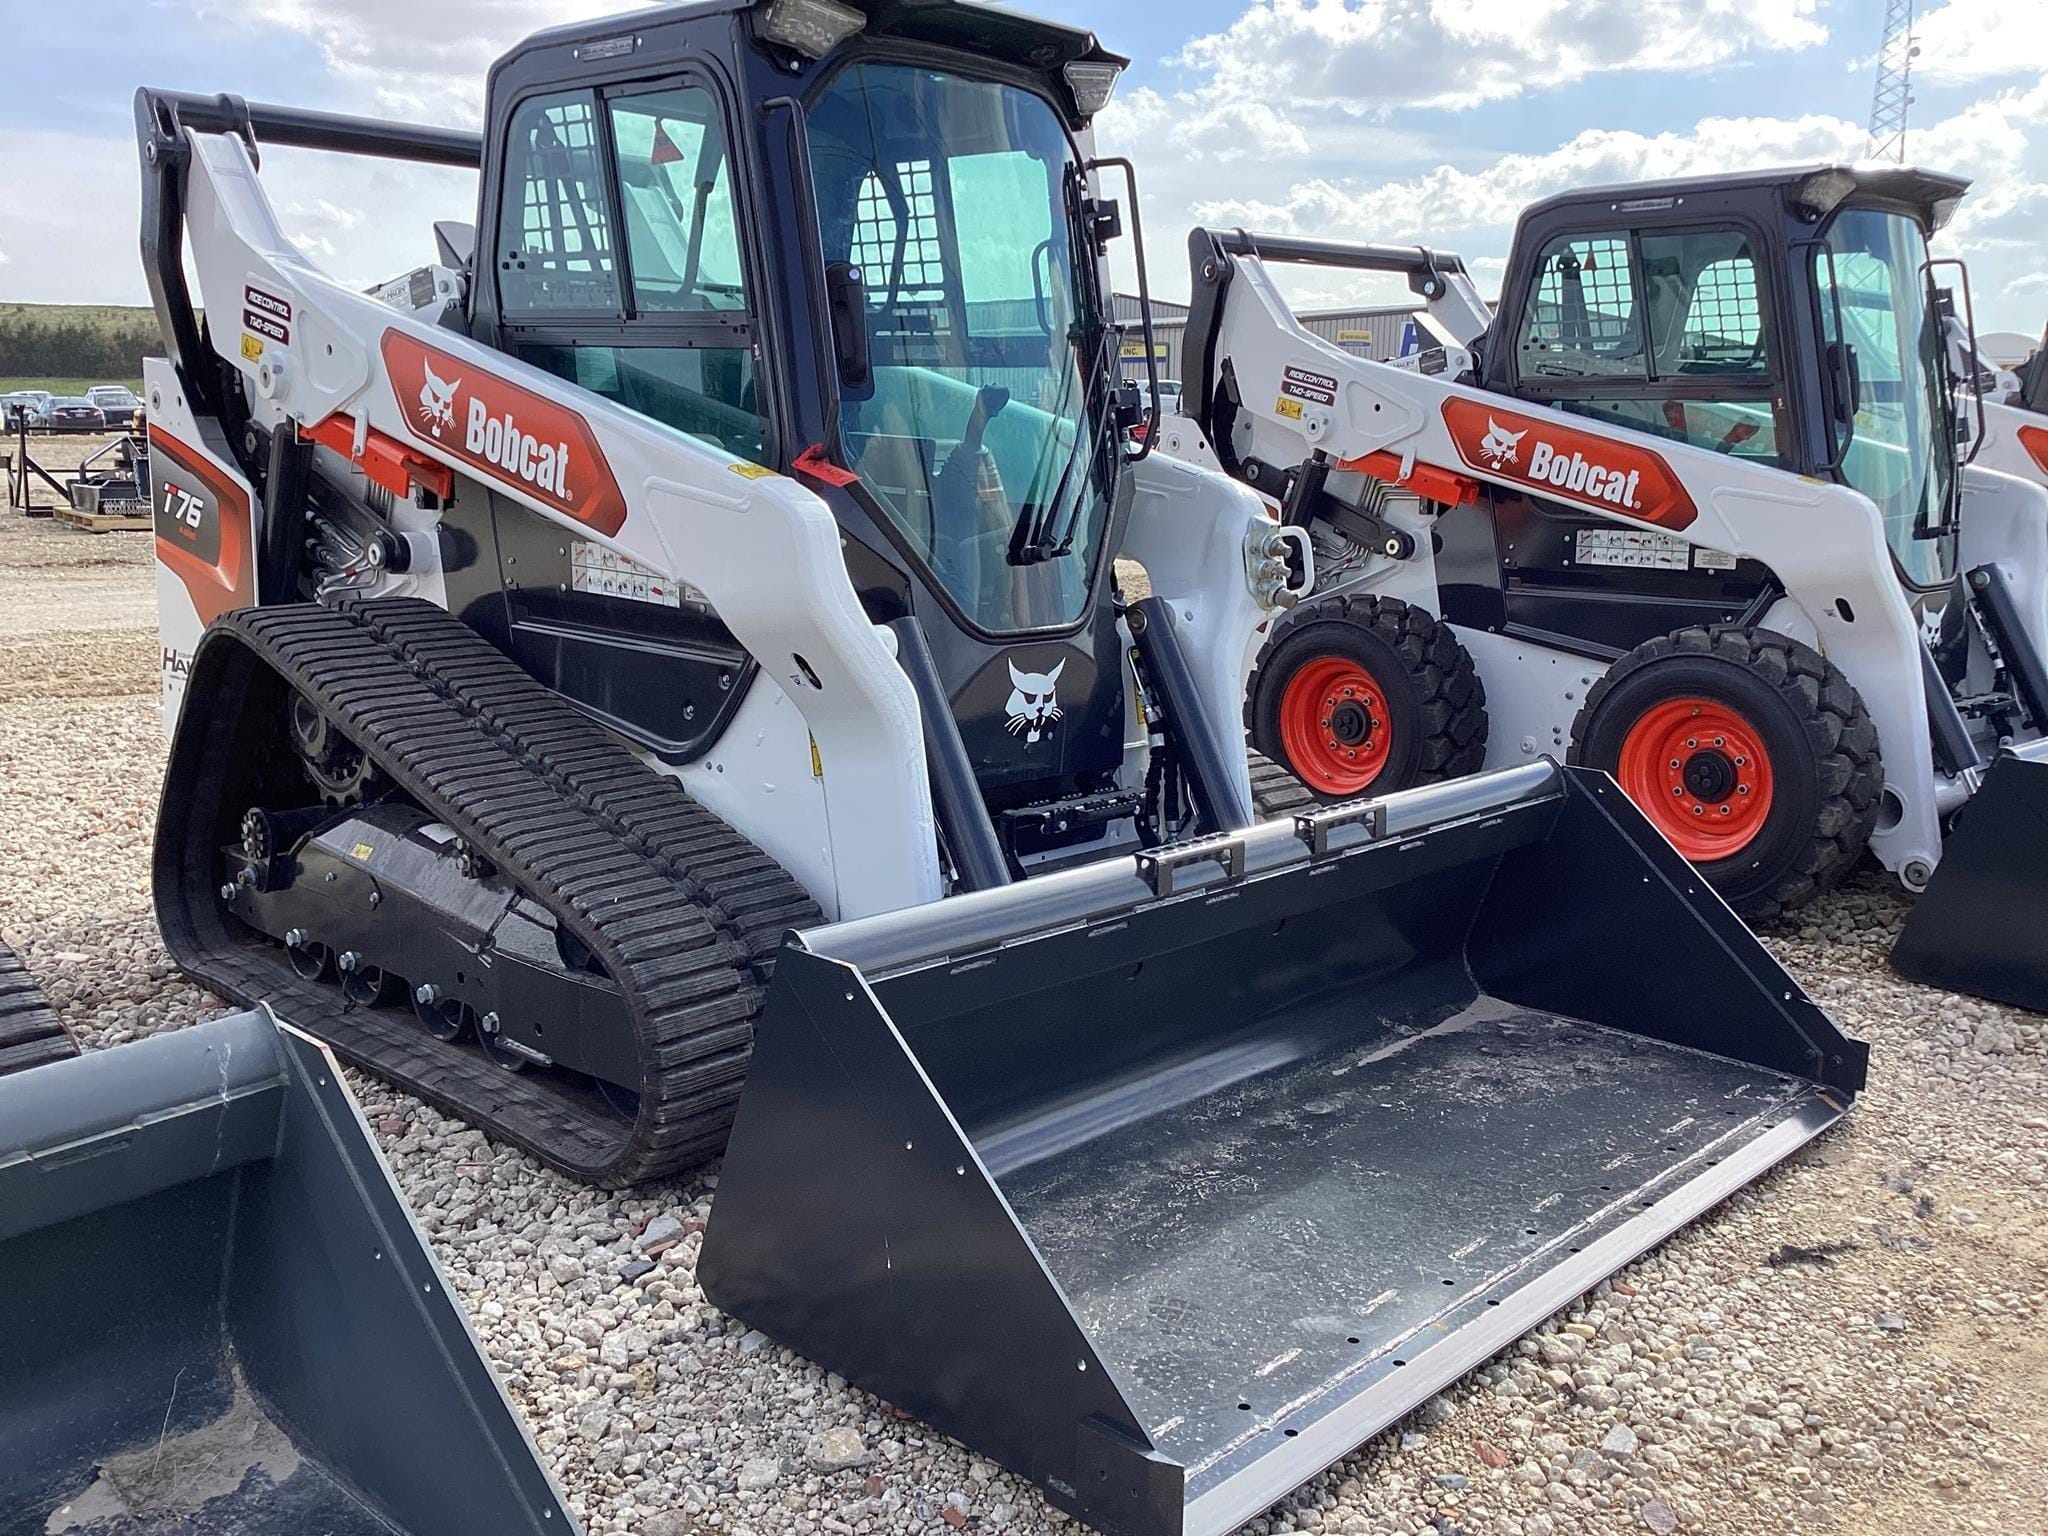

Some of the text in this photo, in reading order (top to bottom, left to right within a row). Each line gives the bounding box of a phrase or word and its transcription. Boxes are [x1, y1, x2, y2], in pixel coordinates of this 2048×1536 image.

[262, 297, 289, 317] CONTROL
[249, 315, 285, 339] TWO-SPEED
[1288, 369, 1335, 389] RIDE CONTROL
[1289, 385, 1329, 402] TWO-SPEED
[465, 396, 569, 499] Bobcat
[1527, 441, 1640, 508] Bobcat
[163, 482, 204, 529] T76
